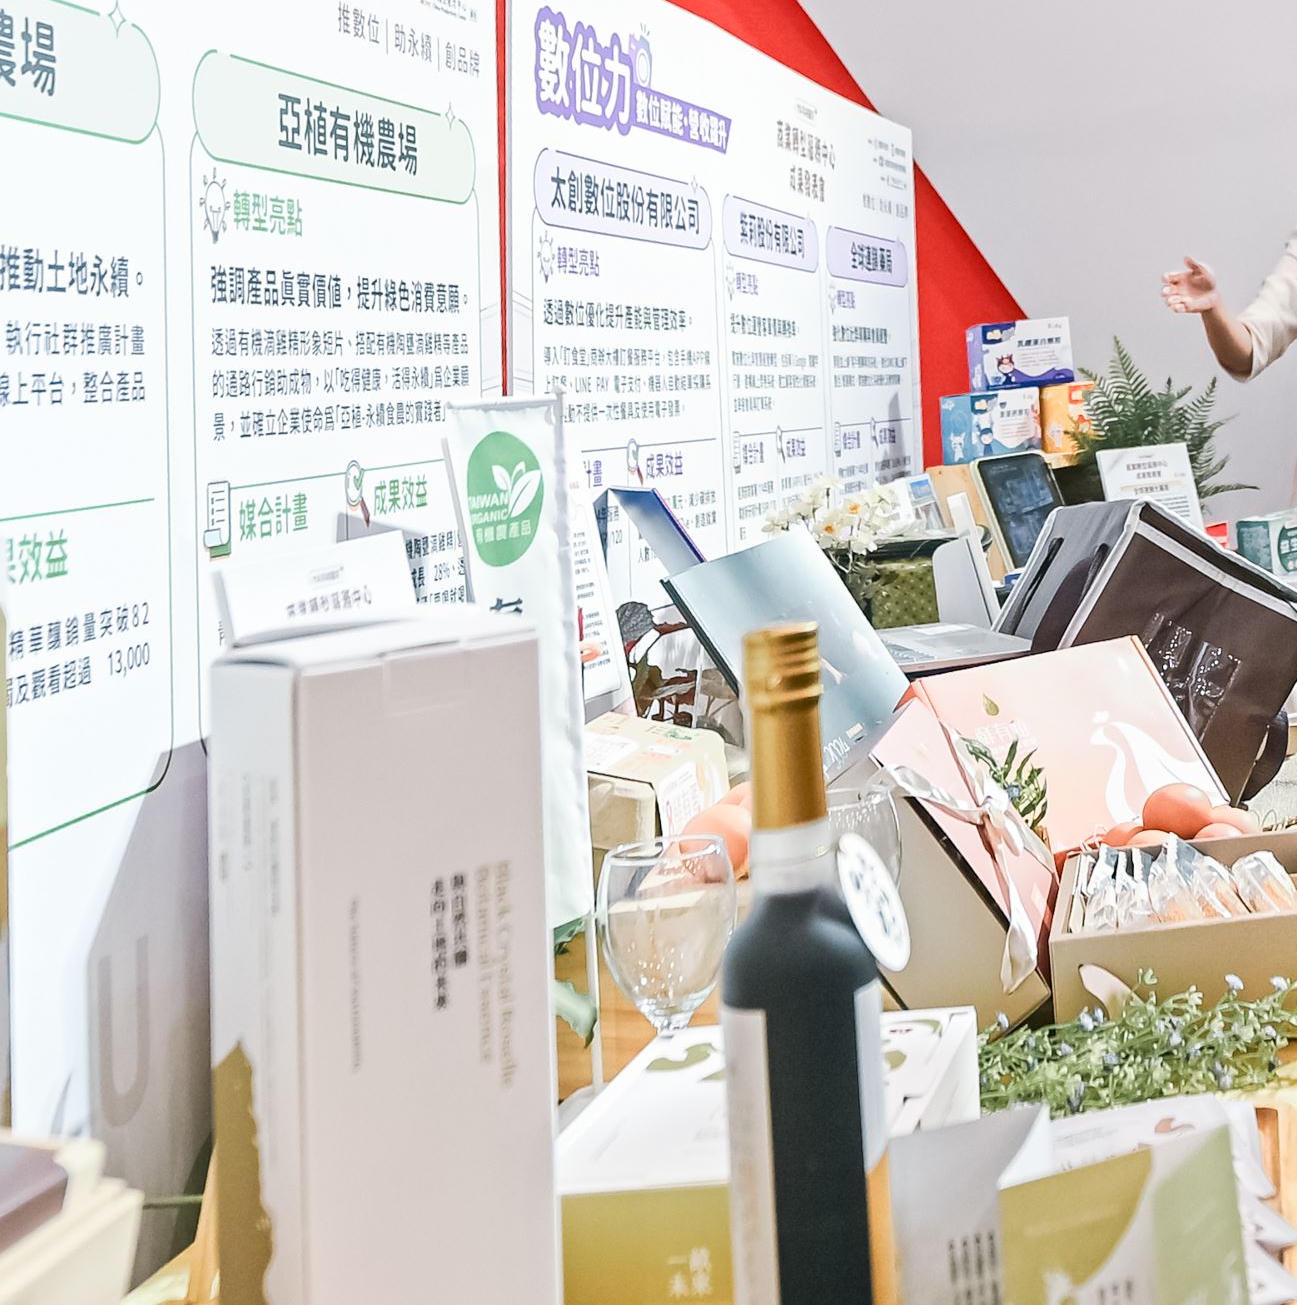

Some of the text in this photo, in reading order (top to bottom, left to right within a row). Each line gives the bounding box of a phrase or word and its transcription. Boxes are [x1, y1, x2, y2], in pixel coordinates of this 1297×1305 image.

[338, 1, 481, 77] 推數位 助永續 創品牌
[536, 17, 633, 126] 數位力
[277, 92, 419, 177] 亞植有機農場
[233, 189, 304, 237] 轉型亮點
[556, 245, 600, 278] 轉型亮點
[596, 375, 610, 392] PAY
[645, 450, 684, 479] 成果效益
[238, 492, 309, 543] 媒合計畫
[373, 474, 429, 516] 成果效益
[107, 642, 151, 678] 13,000
